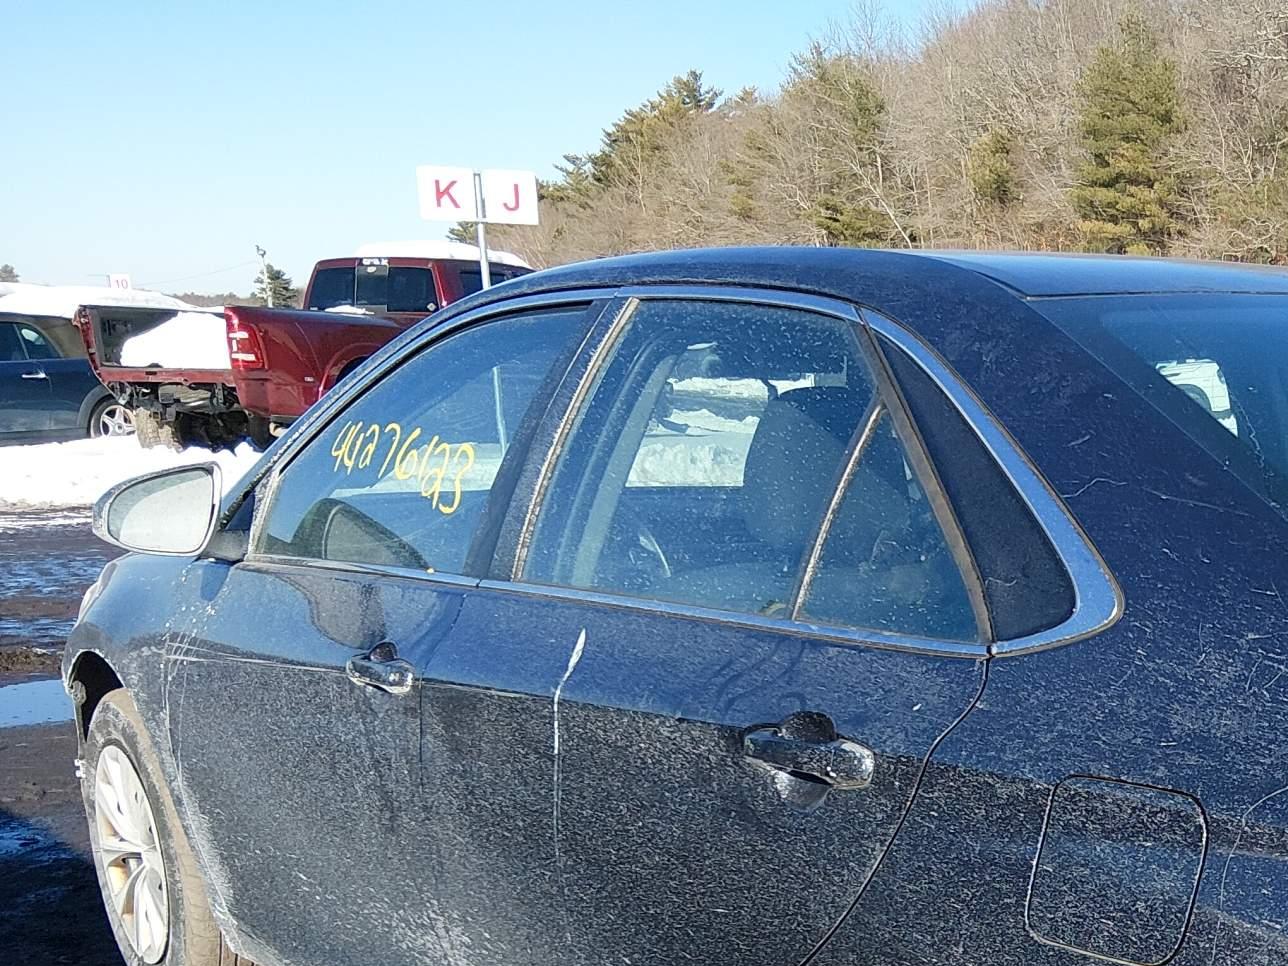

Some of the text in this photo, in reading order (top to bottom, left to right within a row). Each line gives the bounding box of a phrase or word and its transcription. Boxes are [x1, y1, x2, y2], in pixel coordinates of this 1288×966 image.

[434, 179, 461, 208] K
[503, 183, 520, 211] J
[114, 279, 128, 290] 10
[331, 420, 475, 514] 44276123
